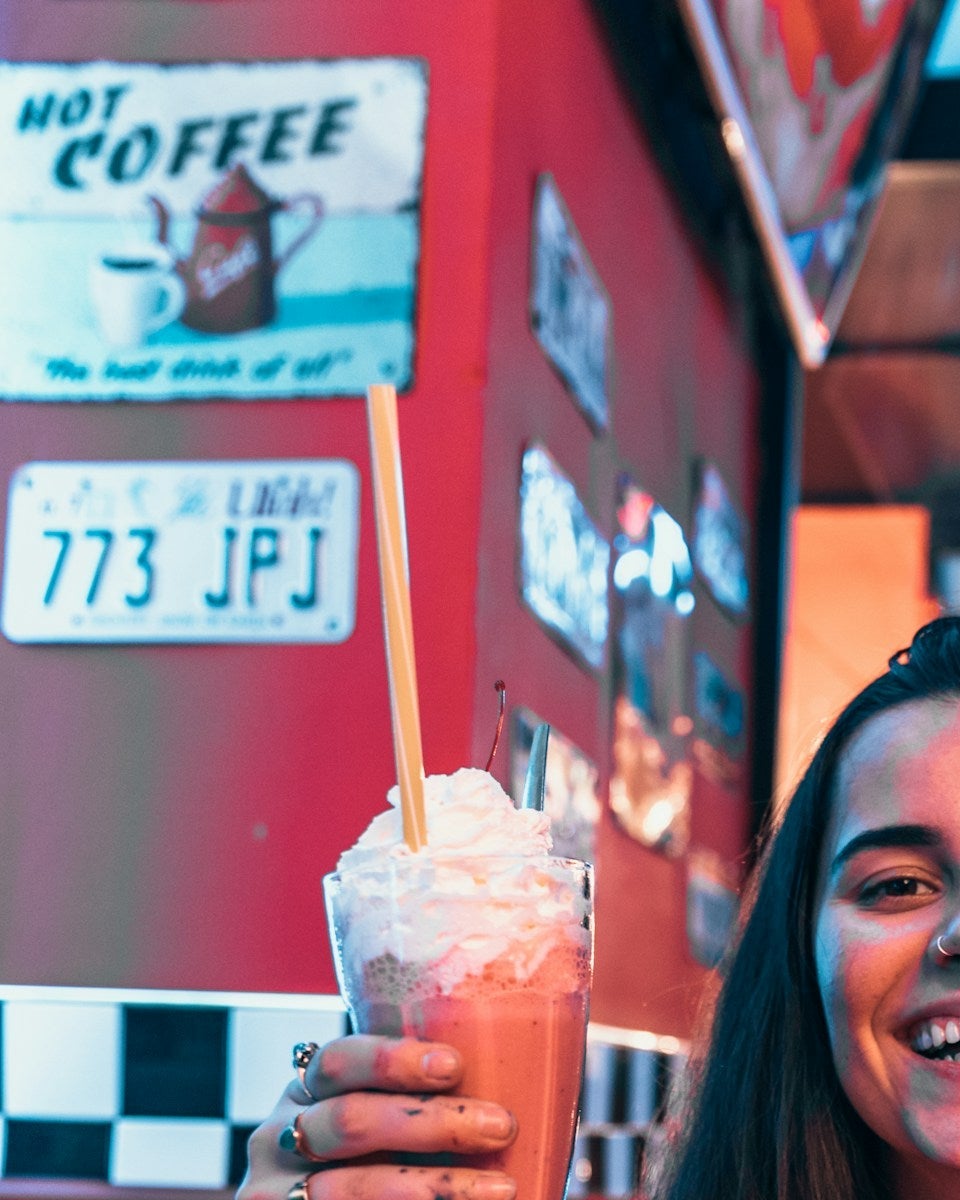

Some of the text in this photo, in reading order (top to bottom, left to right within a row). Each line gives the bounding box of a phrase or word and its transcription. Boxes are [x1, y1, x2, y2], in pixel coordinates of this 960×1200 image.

[17, 83, 129, 133] HOT
[53, 97, 357, 190] COFFEE
[41, 525, 325, 611] 773 JPJ
